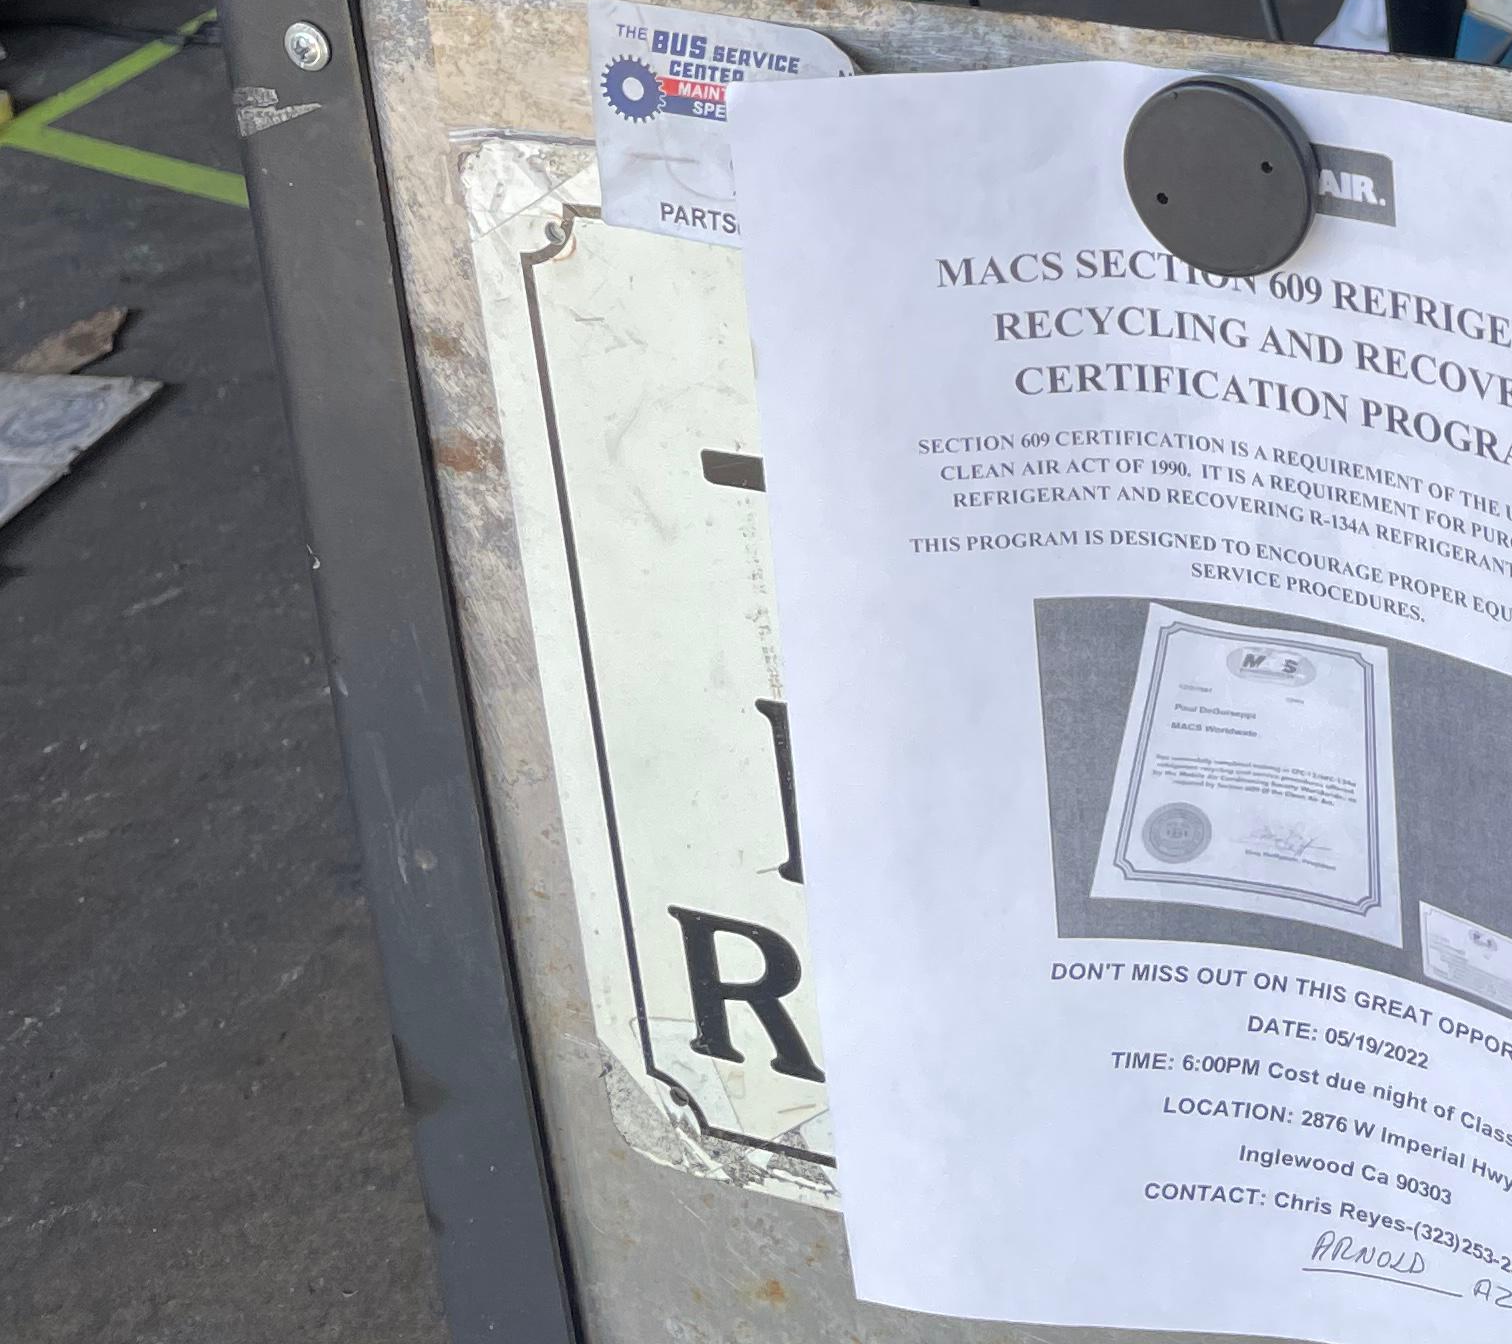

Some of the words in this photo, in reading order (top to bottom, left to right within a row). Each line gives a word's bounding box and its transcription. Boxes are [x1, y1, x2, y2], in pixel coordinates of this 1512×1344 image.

[616, 24, 649, 41] THE
[651, 30, 708, 60] BUS
[712, 44, 800, 74] SERVICE
[669, 60, 745, 82] CENTER
[936, 252, 1064, 288] MACS
[1270, 272, 1322, 304] 609
[992, 306, 1250, 348] RECYCLING
[1259, 326, 1342, 364] AND
[1016, 364, 1348, 424] CERTIFICATION
[918, 434, 1014, 454] SECTION
[1021, 432, 1050, 449] 609
[1055, 430, 1225, 454] CERTIFICATION
[1231, 440, 1248, 457] IS
[1254, 446, 1268, 460] A
[1272, 448, 1423, 494] REQUIREMENT
[1428, 481, 1455, 503] OF
[1459, 488, 1501, 517] THE
[940, 462, 1014, 480] CLEAN
[1022, 460, 1060, 476] AIR
[1066, 458, 1110, 474] ACT
[1116, 458, 1144, 474] OF
[1152, 460, 1191, 478] 1990.
[1202, 464, 1222, 480] IT
[1228, 468, 1246, 484] IS
[1252, 472, 1264, 487] A
[1270, 475, 1420, 520] REQUIREMENT
[1426, 509, 1466, 534] FOR
[954, 486, 1111, 508] REFRIGERANT
[1117, 486, 1160, 502] AND
[1167, 488, 1304, 522] RECOVERING
[1310, 510, 1370, 536] R-134A
[909, 536, 960, 552] THIS
[967, 531, 1078, 550] PROGRAM
[1085, 530, 1104, 544] IS
[1110, 530, 1216, 551] DESIGNED
[1222, 538, 1250, 556] TO
[1256, 544, 1383, 584] ENCOURAGE
[1388, 572, 1468, 608] PROPER
[1192, 563, 1280, 588] SERVICE
[1287, 576, 1425, 622] PROCEDURES.
[1051, 963, 1126, 980] DON'T
[1132, 964, 1188, 982] MISS
[1197, 968, 1248, 986] OUT
[1254, 972, 1288, 992] ON
[1296, 978, 1346, 1002] THIS
[1354, 991, 1433, 1026] GREAT
[1248, 1016, 1318, 1040] DATE:
[1325, 1028, 1428, 1070] 05/19/2022
[1112, 1052, 1174, 1070] TIME:
[1182, 1054, 1260, 1076] 6:00PM
[1268, 1062, 1319, 1085] Cost
[1326, 1072, 1366, 1094] due
[1373, 1086, 1428, 1112] night
[1434, 1105, 1456, 1121] of
[1164, 1096, 1293, 1124] LOCATION:
[1302, 1110, 1347, 1132] 2876
[1354, 1120, 1376, 1138] W
[1381, 1127, 1465, 1168] Imperial
[1145, 1183, 1266, 1206] CONTACT:
[1274, 1192, 1332, 1214] Chris
[1240, 1145, 1354, 1176] Inglewood
[1362, 1164, 1388, 1185] Ca
[1396, 1174, 1452, 1204] 90303
[1312, 1230, 1424, 1274] ARNOLD
